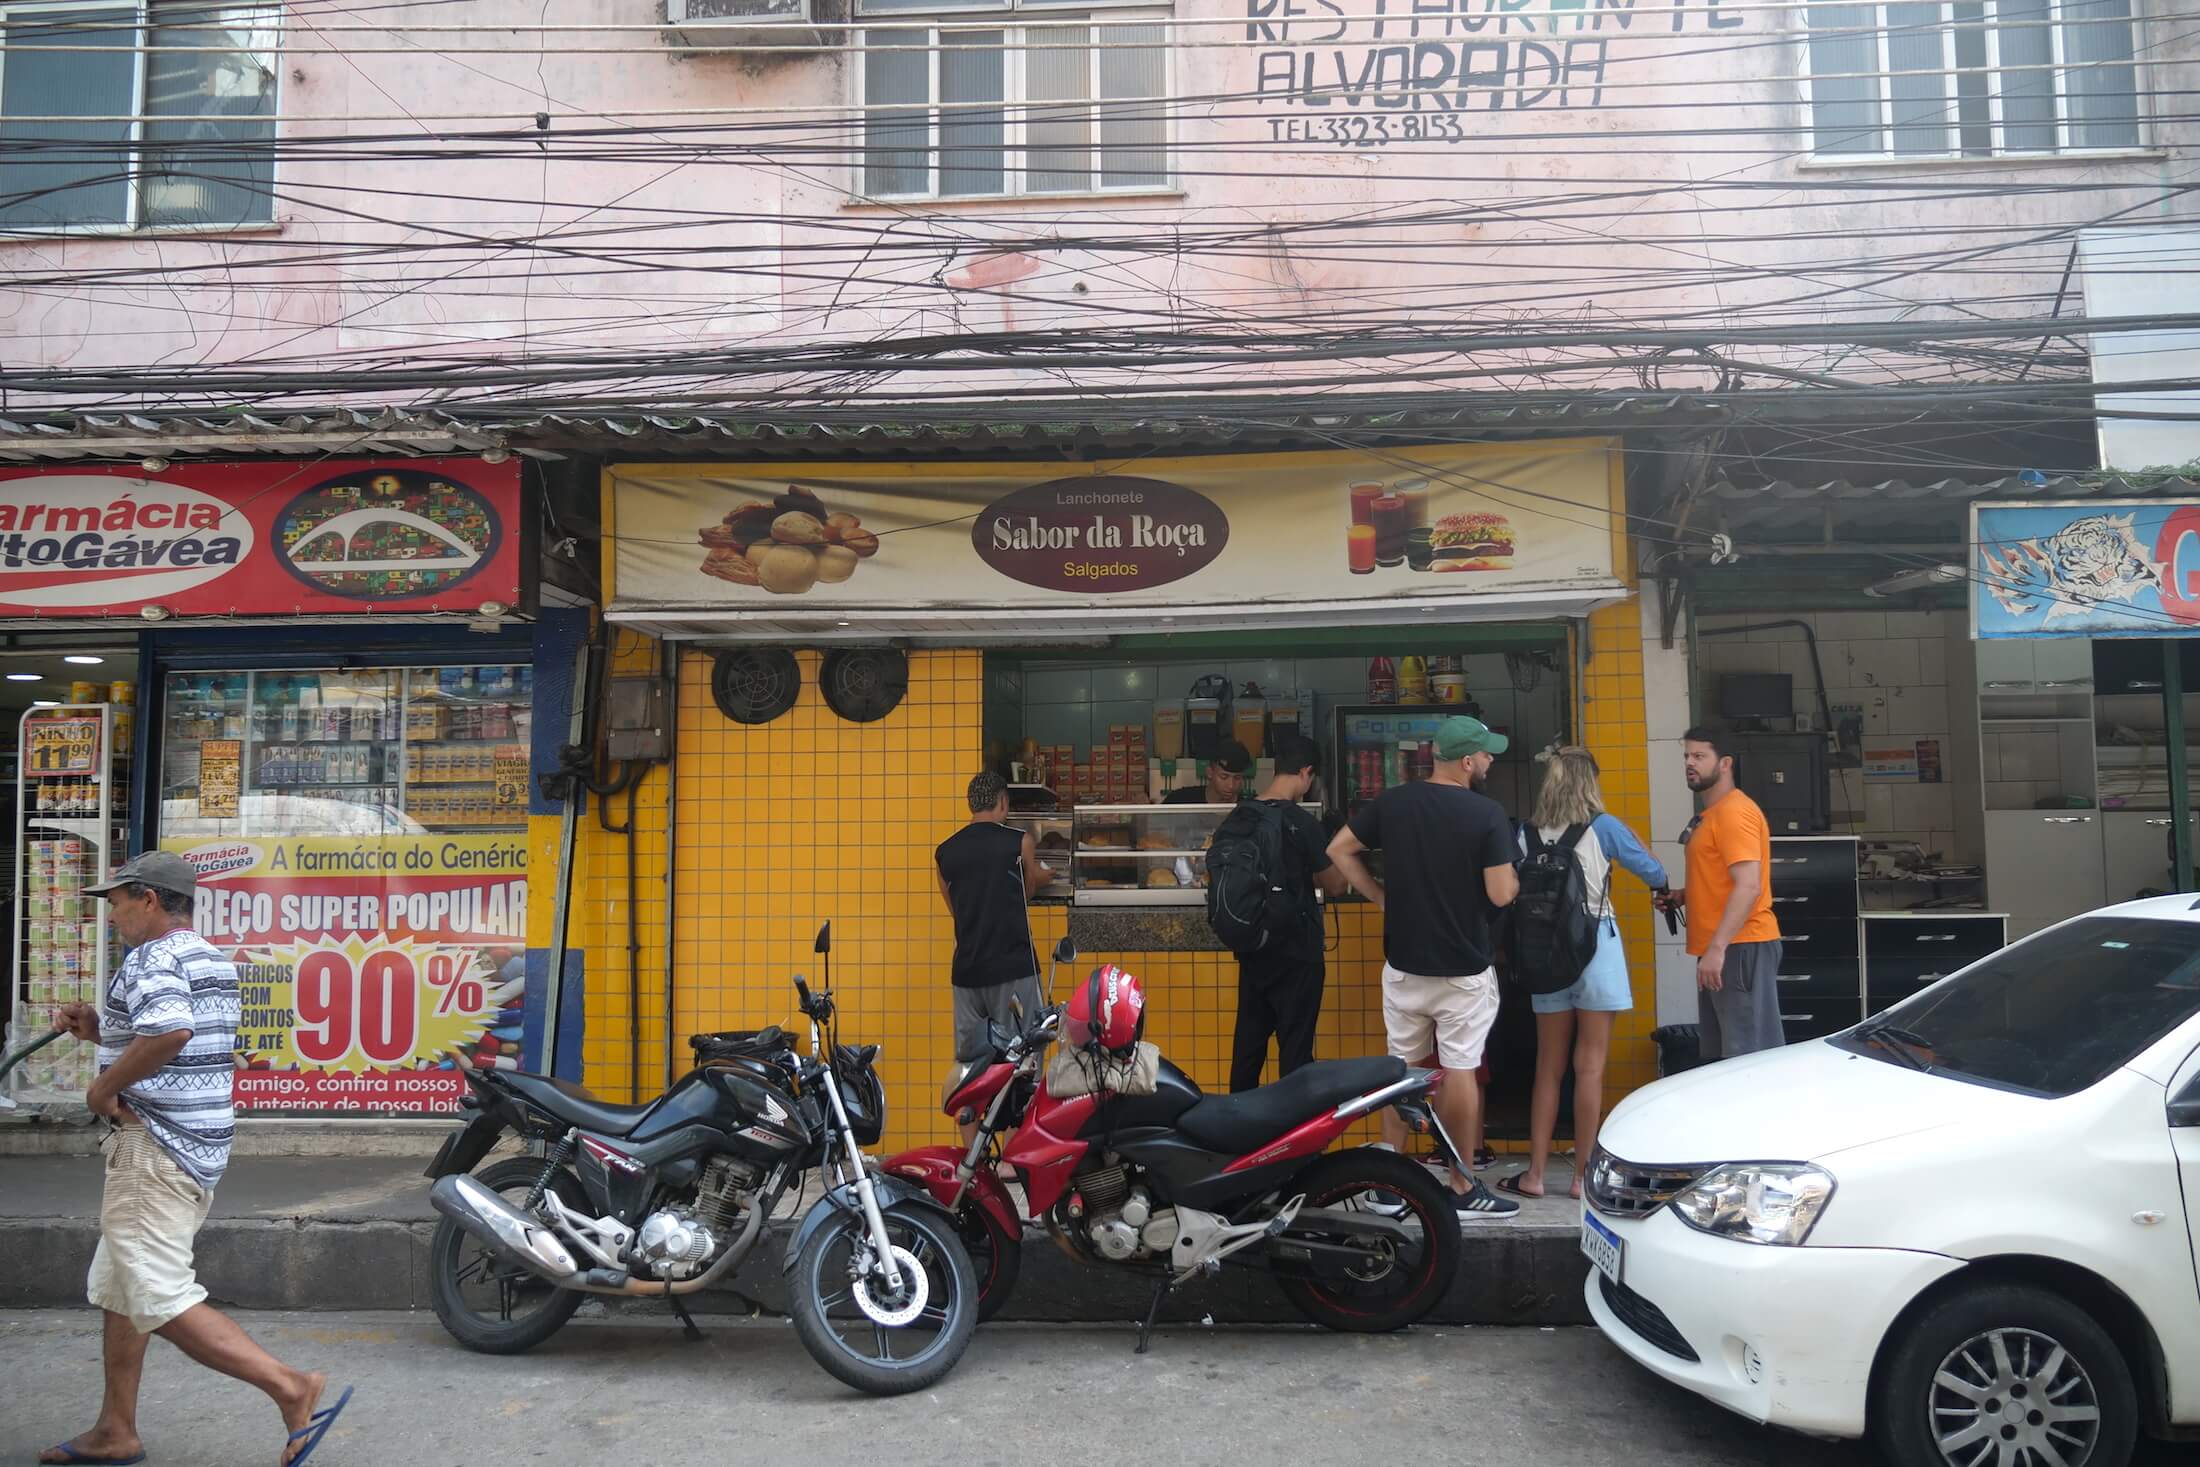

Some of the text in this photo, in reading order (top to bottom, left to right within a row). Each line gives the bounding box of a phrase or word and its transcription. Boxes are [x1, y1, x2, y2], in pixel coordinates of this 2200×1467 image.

[1257, 40, 1608, 110] ALVORADA
[1057, 491, 1144, 505] Lanchonete
[0, 494, 221, 532] armácia
[993, 514, 1206, 556] Sabor da Roça
[0, 533, 241, 568] toGávea
[1064, 562, 1138, 579] Salgados
[497, 760, 528, 768] VIAGR
[183, 846, 249, 863] Farmácia
[271, 843, 528, 870] A farmácia do Genéric
[193, 857, 254, 873] toGávea
[193, 880, 528, 943] REÇO SUPER POPULAR
[237, 965, 293, 983] NERICOS
[241, 987, 271, 1005] COM
[241, 1009, 294, 1028] CONTOS
[234, 1032, 283, 1049] DE ATÉ
[238, 1075, 310, 1093] amigo,
[316, 1074, 388, 1092] confira
[396, 1078, 457, 1092] nossos
[253, 1096, 327, 1109] interior
[332, 1096, 360, 1109] de
[367, 1099, 422, 1112] nossa
[757, 1112, 784, 1127] HONDA
